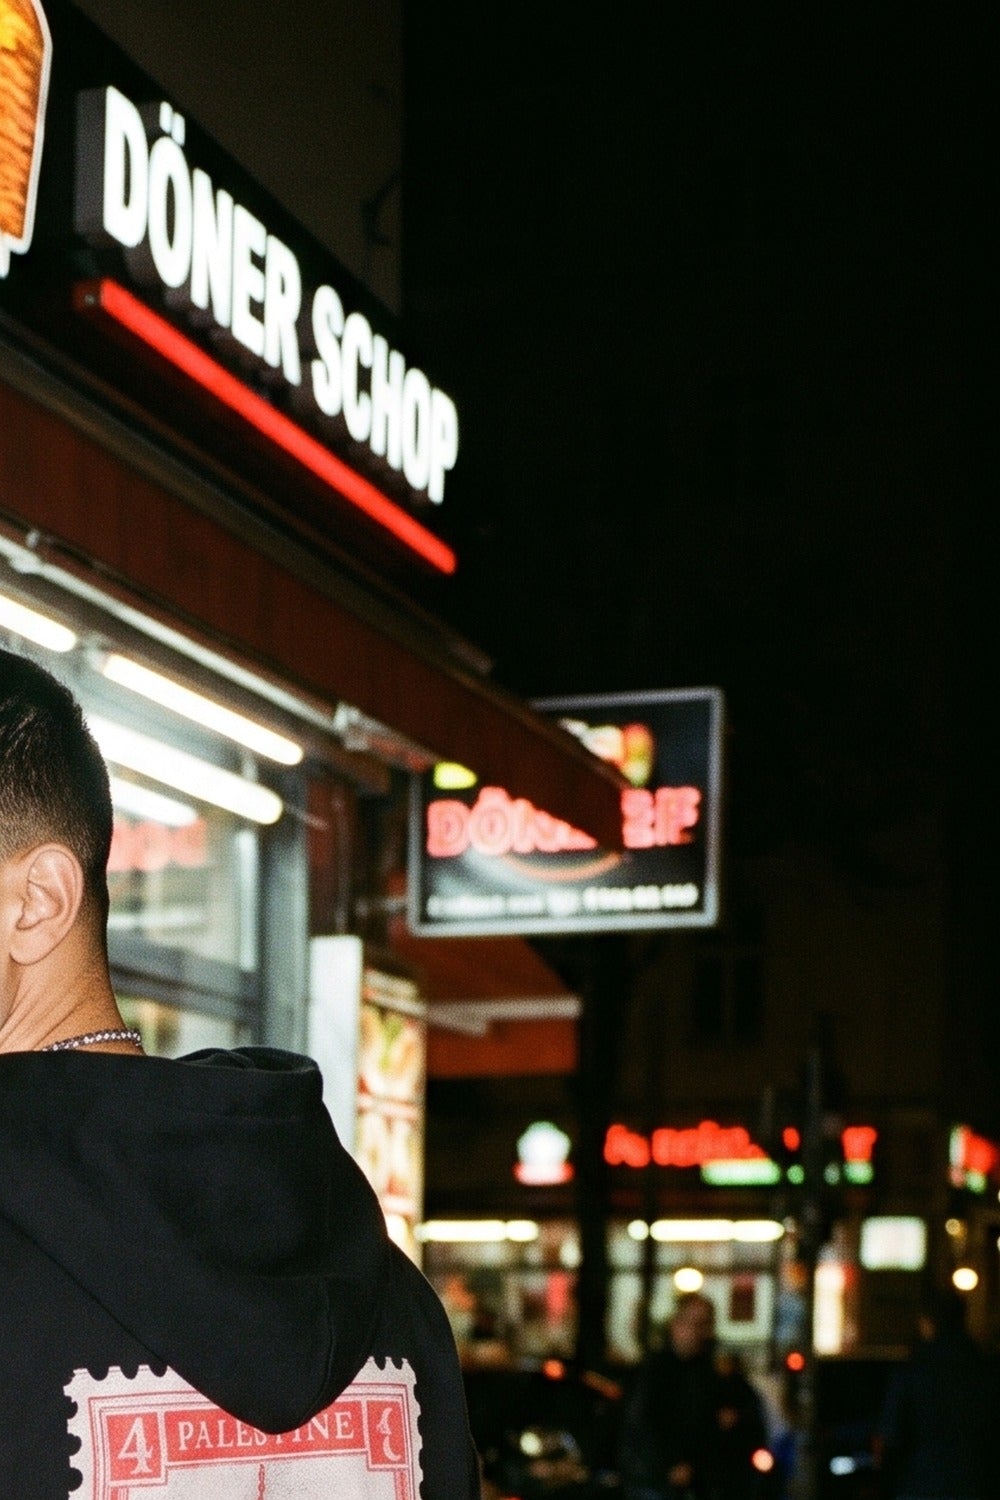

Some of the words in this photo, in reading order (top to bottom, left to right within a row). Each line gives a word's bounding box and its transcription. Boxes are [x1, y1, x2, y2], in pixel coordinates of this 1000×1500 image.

[103, 86, 301, 386] DÖNER
[311, 285, 458, 503] SCHOP
[116, 1415, 154, 1475] 4
